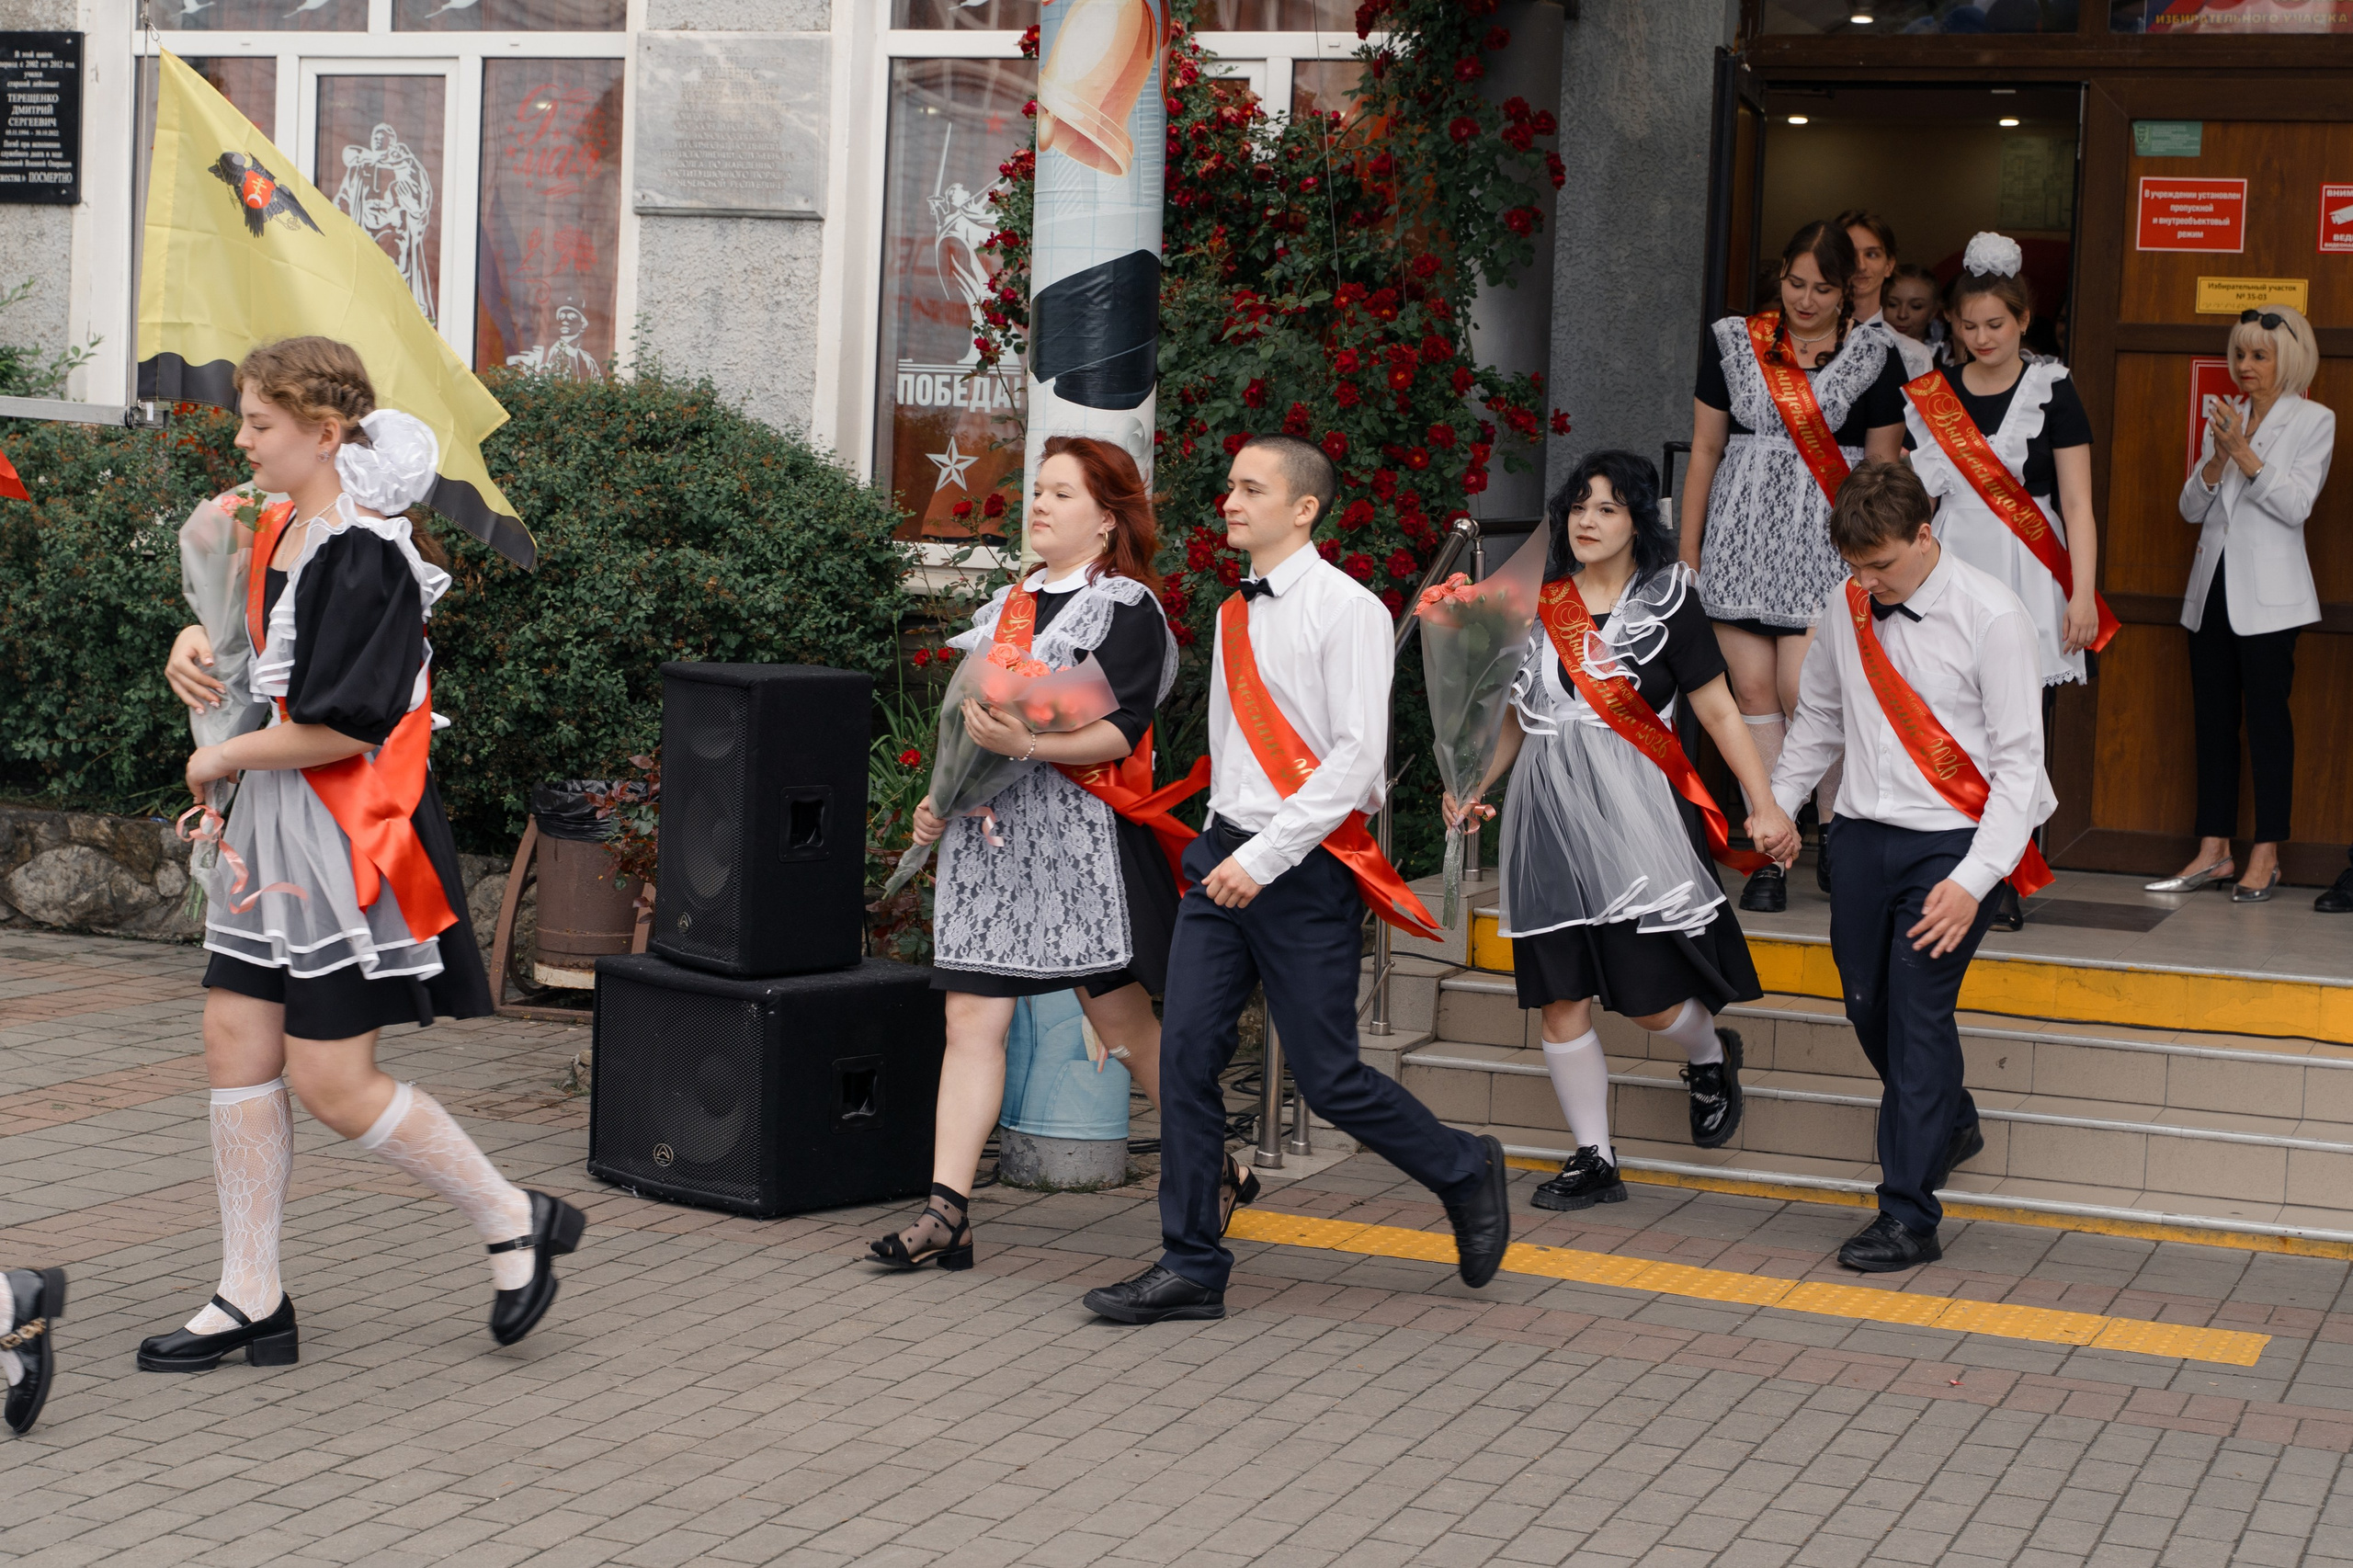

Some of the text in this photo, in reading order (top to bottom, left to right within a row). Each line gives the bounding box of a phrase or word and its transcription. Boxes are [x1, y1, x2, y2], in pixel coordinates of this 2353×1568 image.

[2155, 14, 2348, 24] ИЗБИРАТЕЛЬНОГО УЧАСТКА
[6, 93, 60, 104] ТЕРЕЩЕНКО
[11, 104, 54, 116] ДМИТРИЙ
[7, 117, 57, 127] СЕРГЕЕВИЧ
[28, 172, 73, 183] ПОСМЕРТНО
[2144, 189, 2241, 201] В учреждении установлен
[2170, 203, 2213, 213] пропускной
[2177, 231, 2203, 240] режим
[2208, 282, 2297, 292] Избирательный участок
[897, 373, 1022, 413] ПОБЕДА!
[1765, 345, 1826, 460] ыпускница
[1927, 392, 2048, 541] Выпускница 2026
[1613, 676, 1645, 714] Виктория
[1634, 721, 1671, 759] 2026
[1921, 736, 1968, 781] 2026
